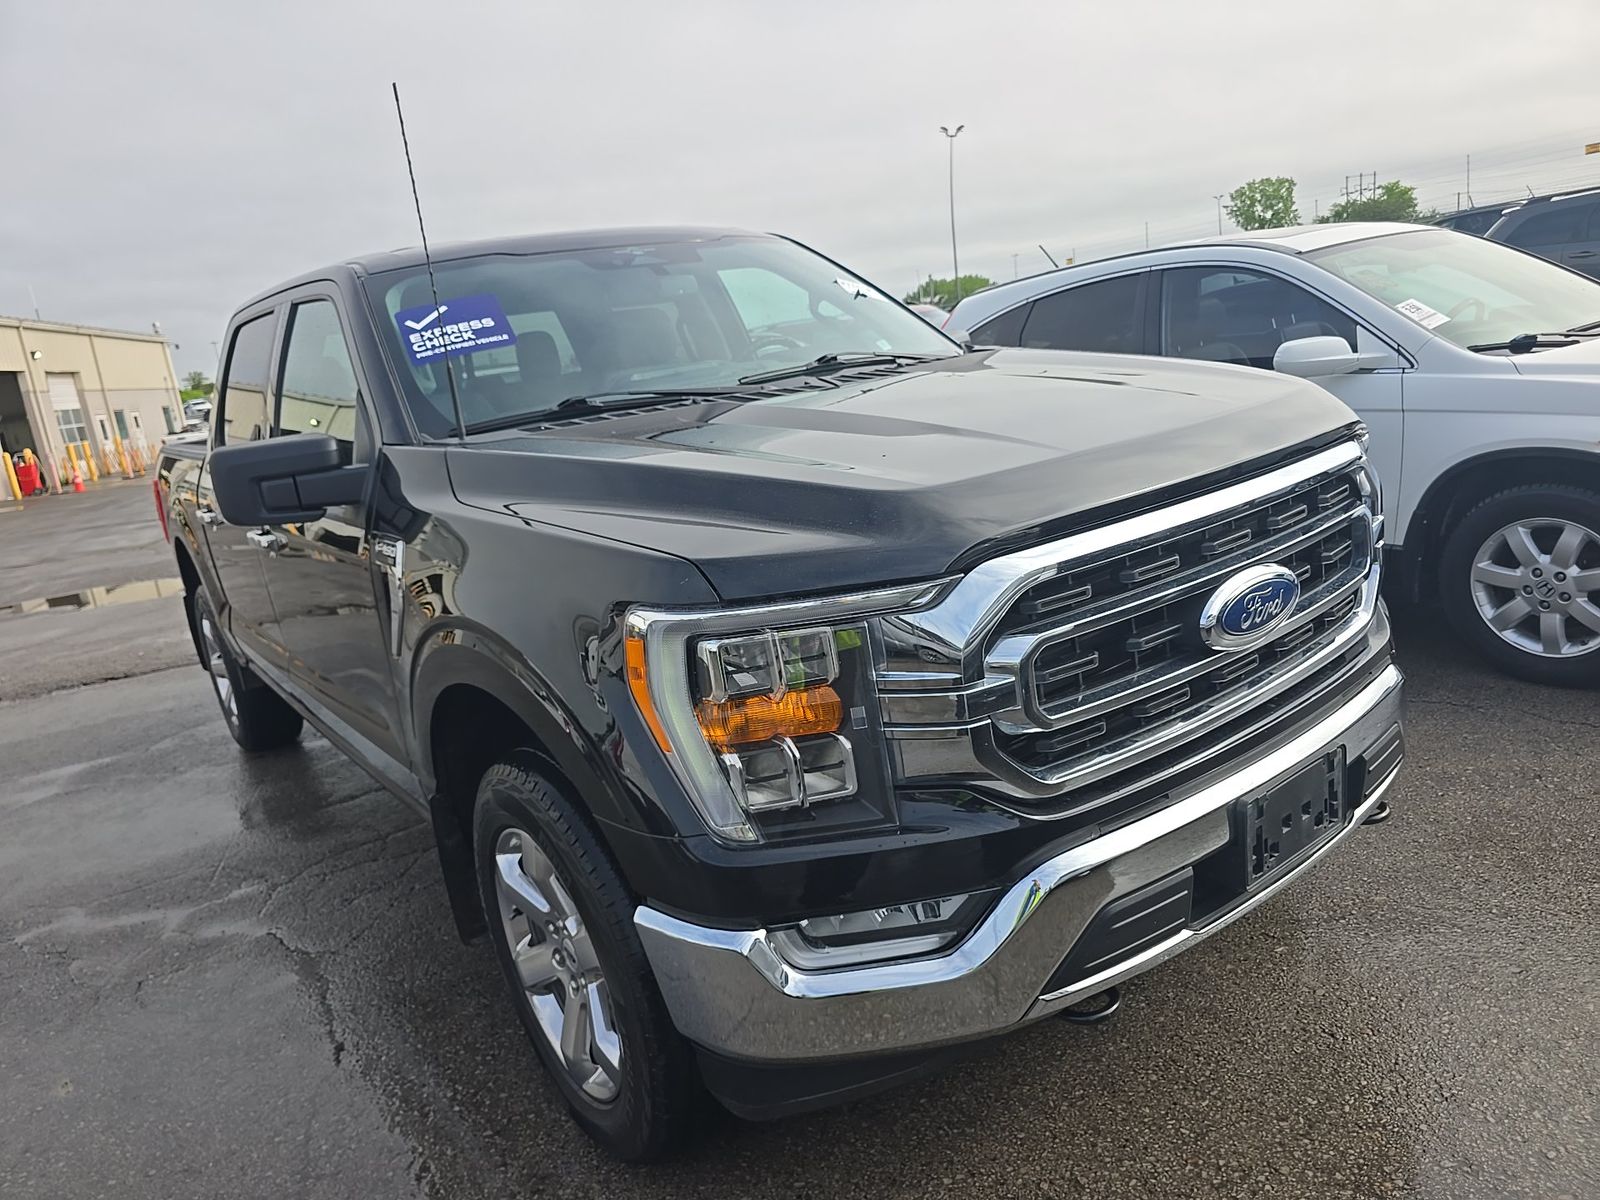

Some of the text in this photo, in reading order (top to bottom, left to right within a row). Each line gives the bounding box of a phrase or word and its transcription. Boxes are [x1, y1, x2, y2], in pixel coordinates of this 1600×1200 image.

[408, 317, 496, 344] EXPRESS
[412, 330, 477, 352] CHECK
[475, 334, 510, 345] VEHICLE
[1240, 586, 1284, 630] Ford
